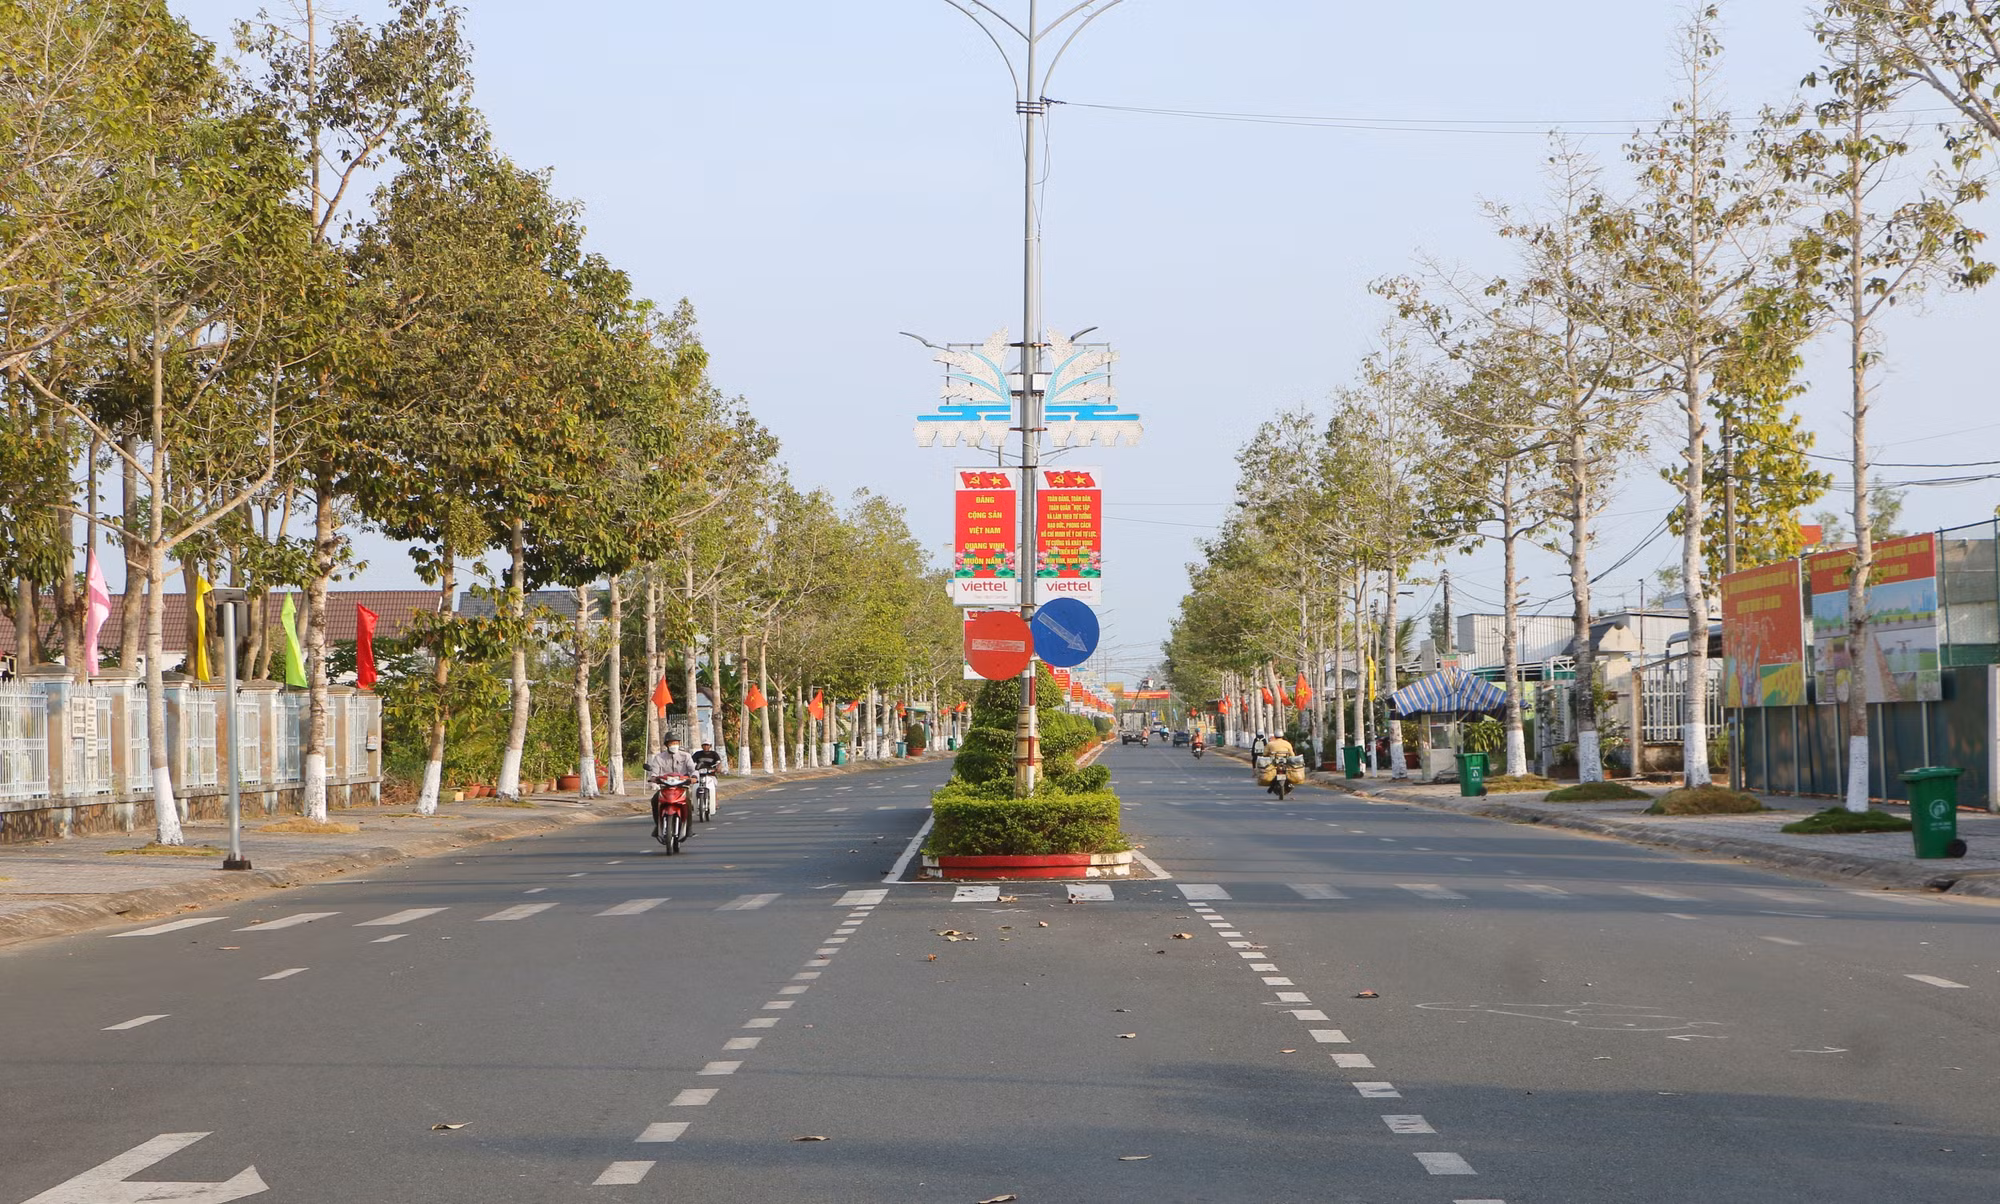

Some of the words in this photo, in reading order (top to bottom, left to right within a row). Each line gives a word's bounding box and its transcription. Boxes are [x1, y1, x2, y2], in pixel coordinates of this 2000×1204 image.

[968, 510, 986, 520] CỘNG
[988, 510, 1002, 518] SẢN
[969, 526, 983, 535] VIỆT
[962, 581, 1008, 592] viettel
[1046, 581, 1092, 592] viettel
